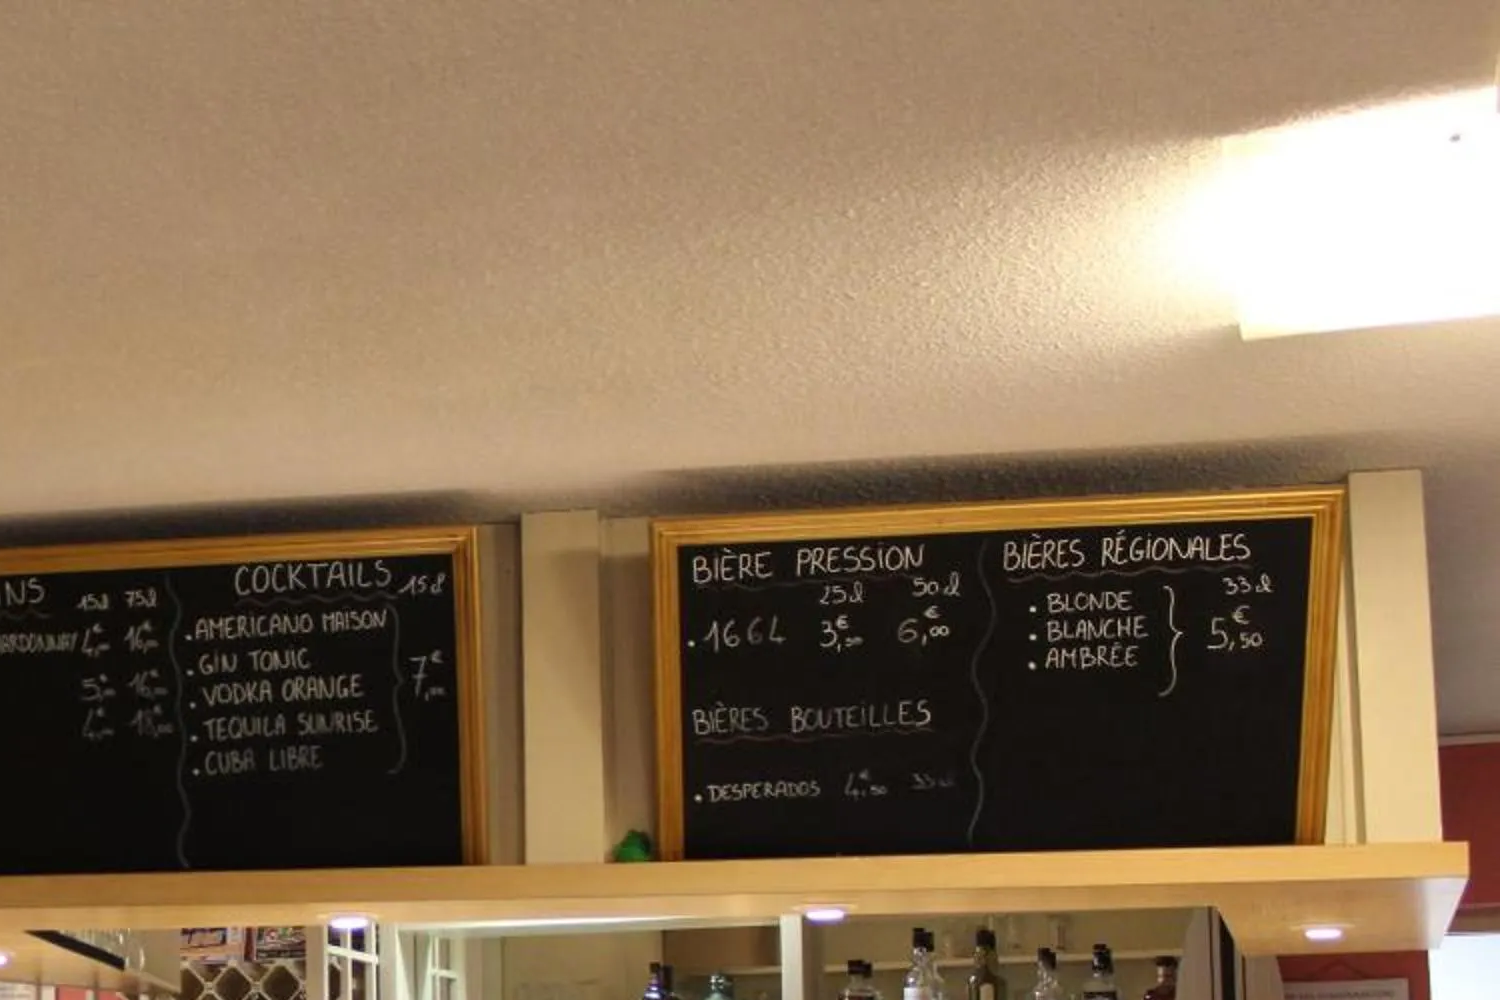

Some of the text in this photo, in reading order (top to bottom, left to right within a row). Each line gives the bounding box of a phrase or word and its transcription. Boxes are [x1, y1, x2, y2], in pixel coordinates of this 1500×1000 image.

[692, 543, 925, 584] BIÈRE PRESSION
[1002, 529, 1251, 571] BIÈRES RÉGIONALES
[234, 559, 392, 596] COCKTAILS
[1047, 591, 1133, 613] BLONDE
[195, 608, 387, 640] AMERICANO MAISON
[1046, 615, 1149, 642] BLANCHE
[199, 648, 311, 675] GIN TONIC
[1045, 643, 1138, 670] AMBRÉE
[202, 673, 365, 706] VODKA ORANGE
[203, 710, 378, 741] TEQUILA SUNRISE
[692, 699, 932, 736] BIÈRES BOUTEILLES
[204, 745, 324, 775] CUBA LIBRE
[707, 780, 821, 803] DESPERADOS
